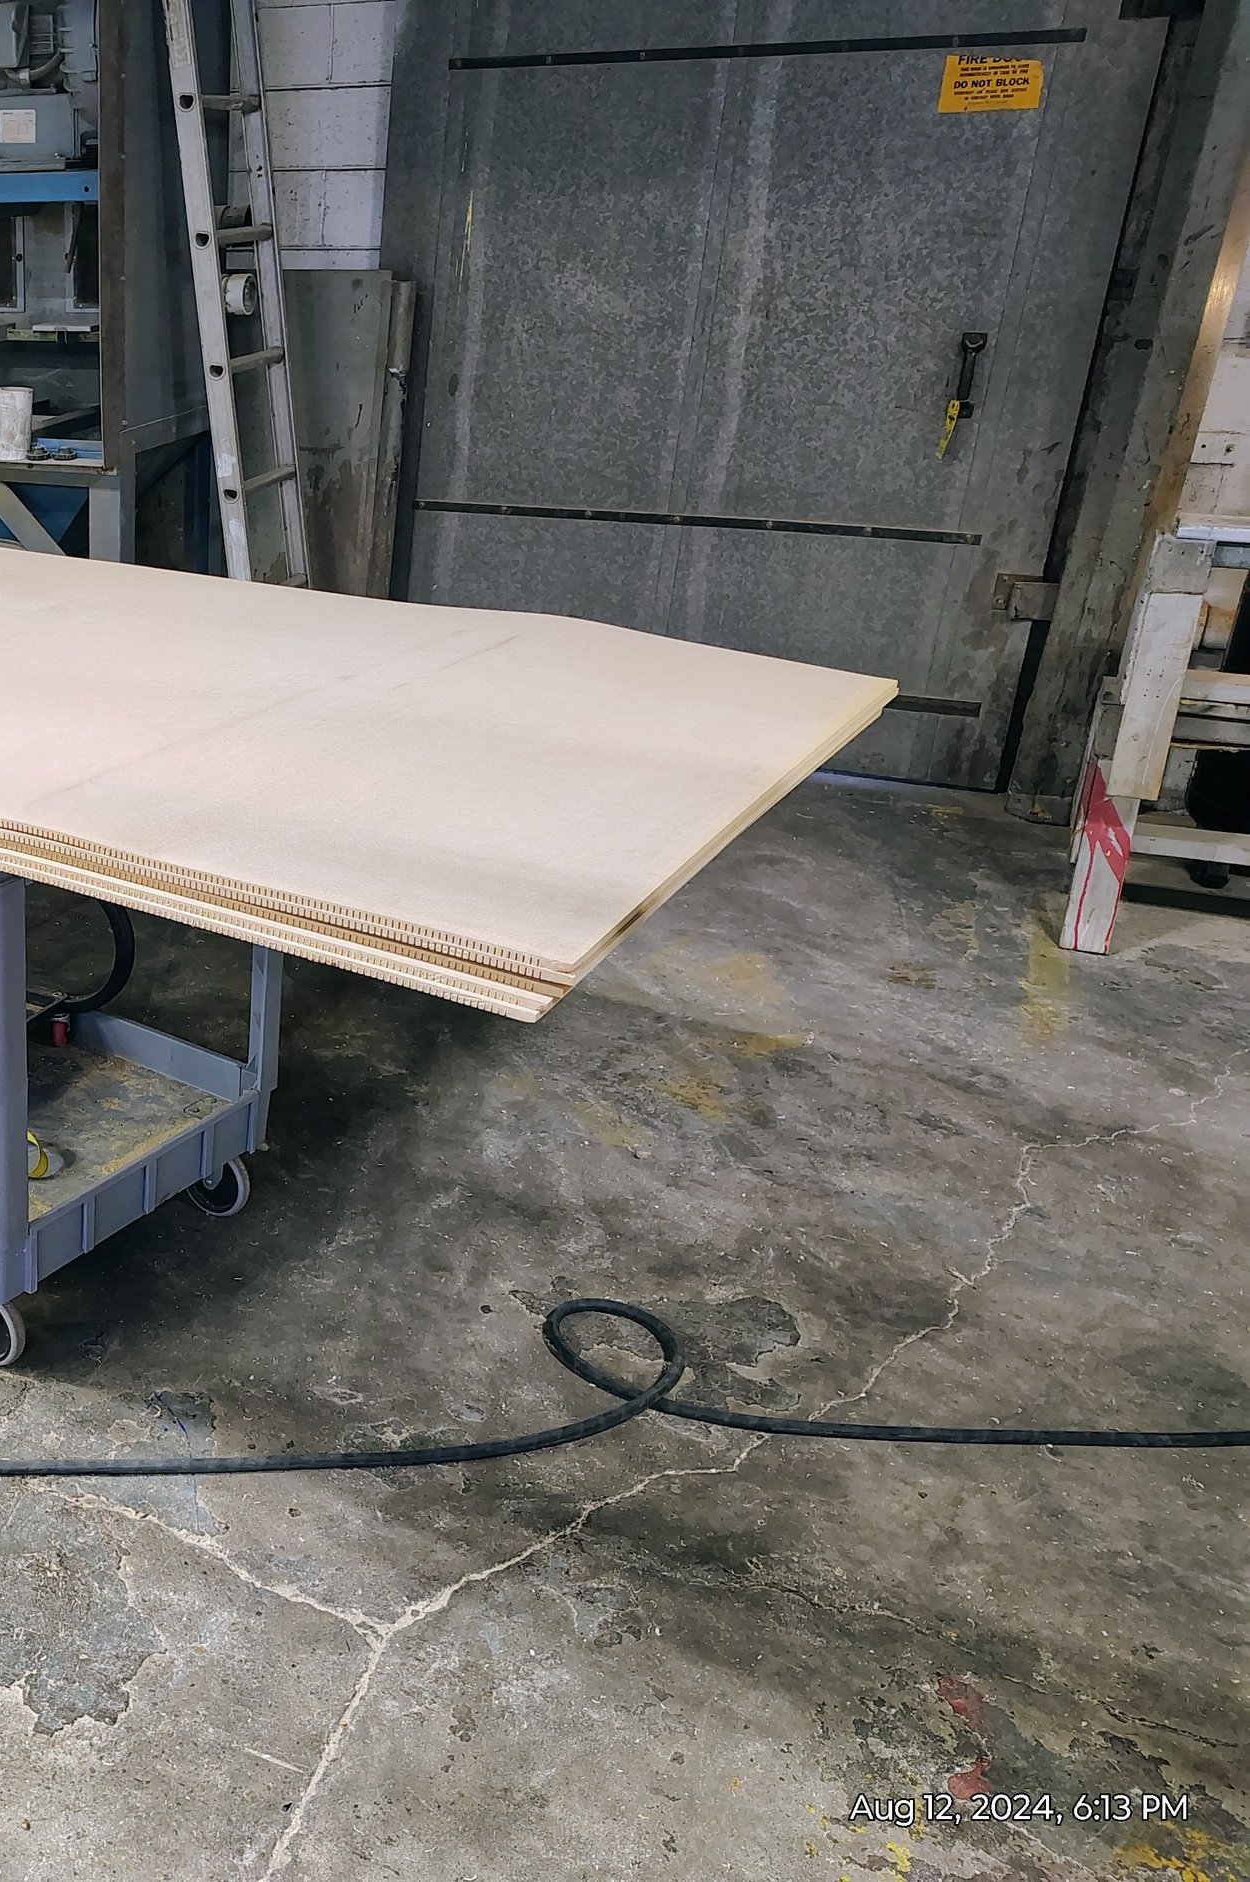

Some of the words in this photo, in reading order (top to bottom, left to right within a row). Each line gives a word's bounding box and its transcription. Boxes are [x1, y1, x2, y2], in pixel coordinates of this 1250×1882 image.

[958, 55, 988, 65] FIRE
[953, 80, 968, 89] DO
[971, 79, 993, 88] NOT
[996, 77, 1030, 87] BLOCK
